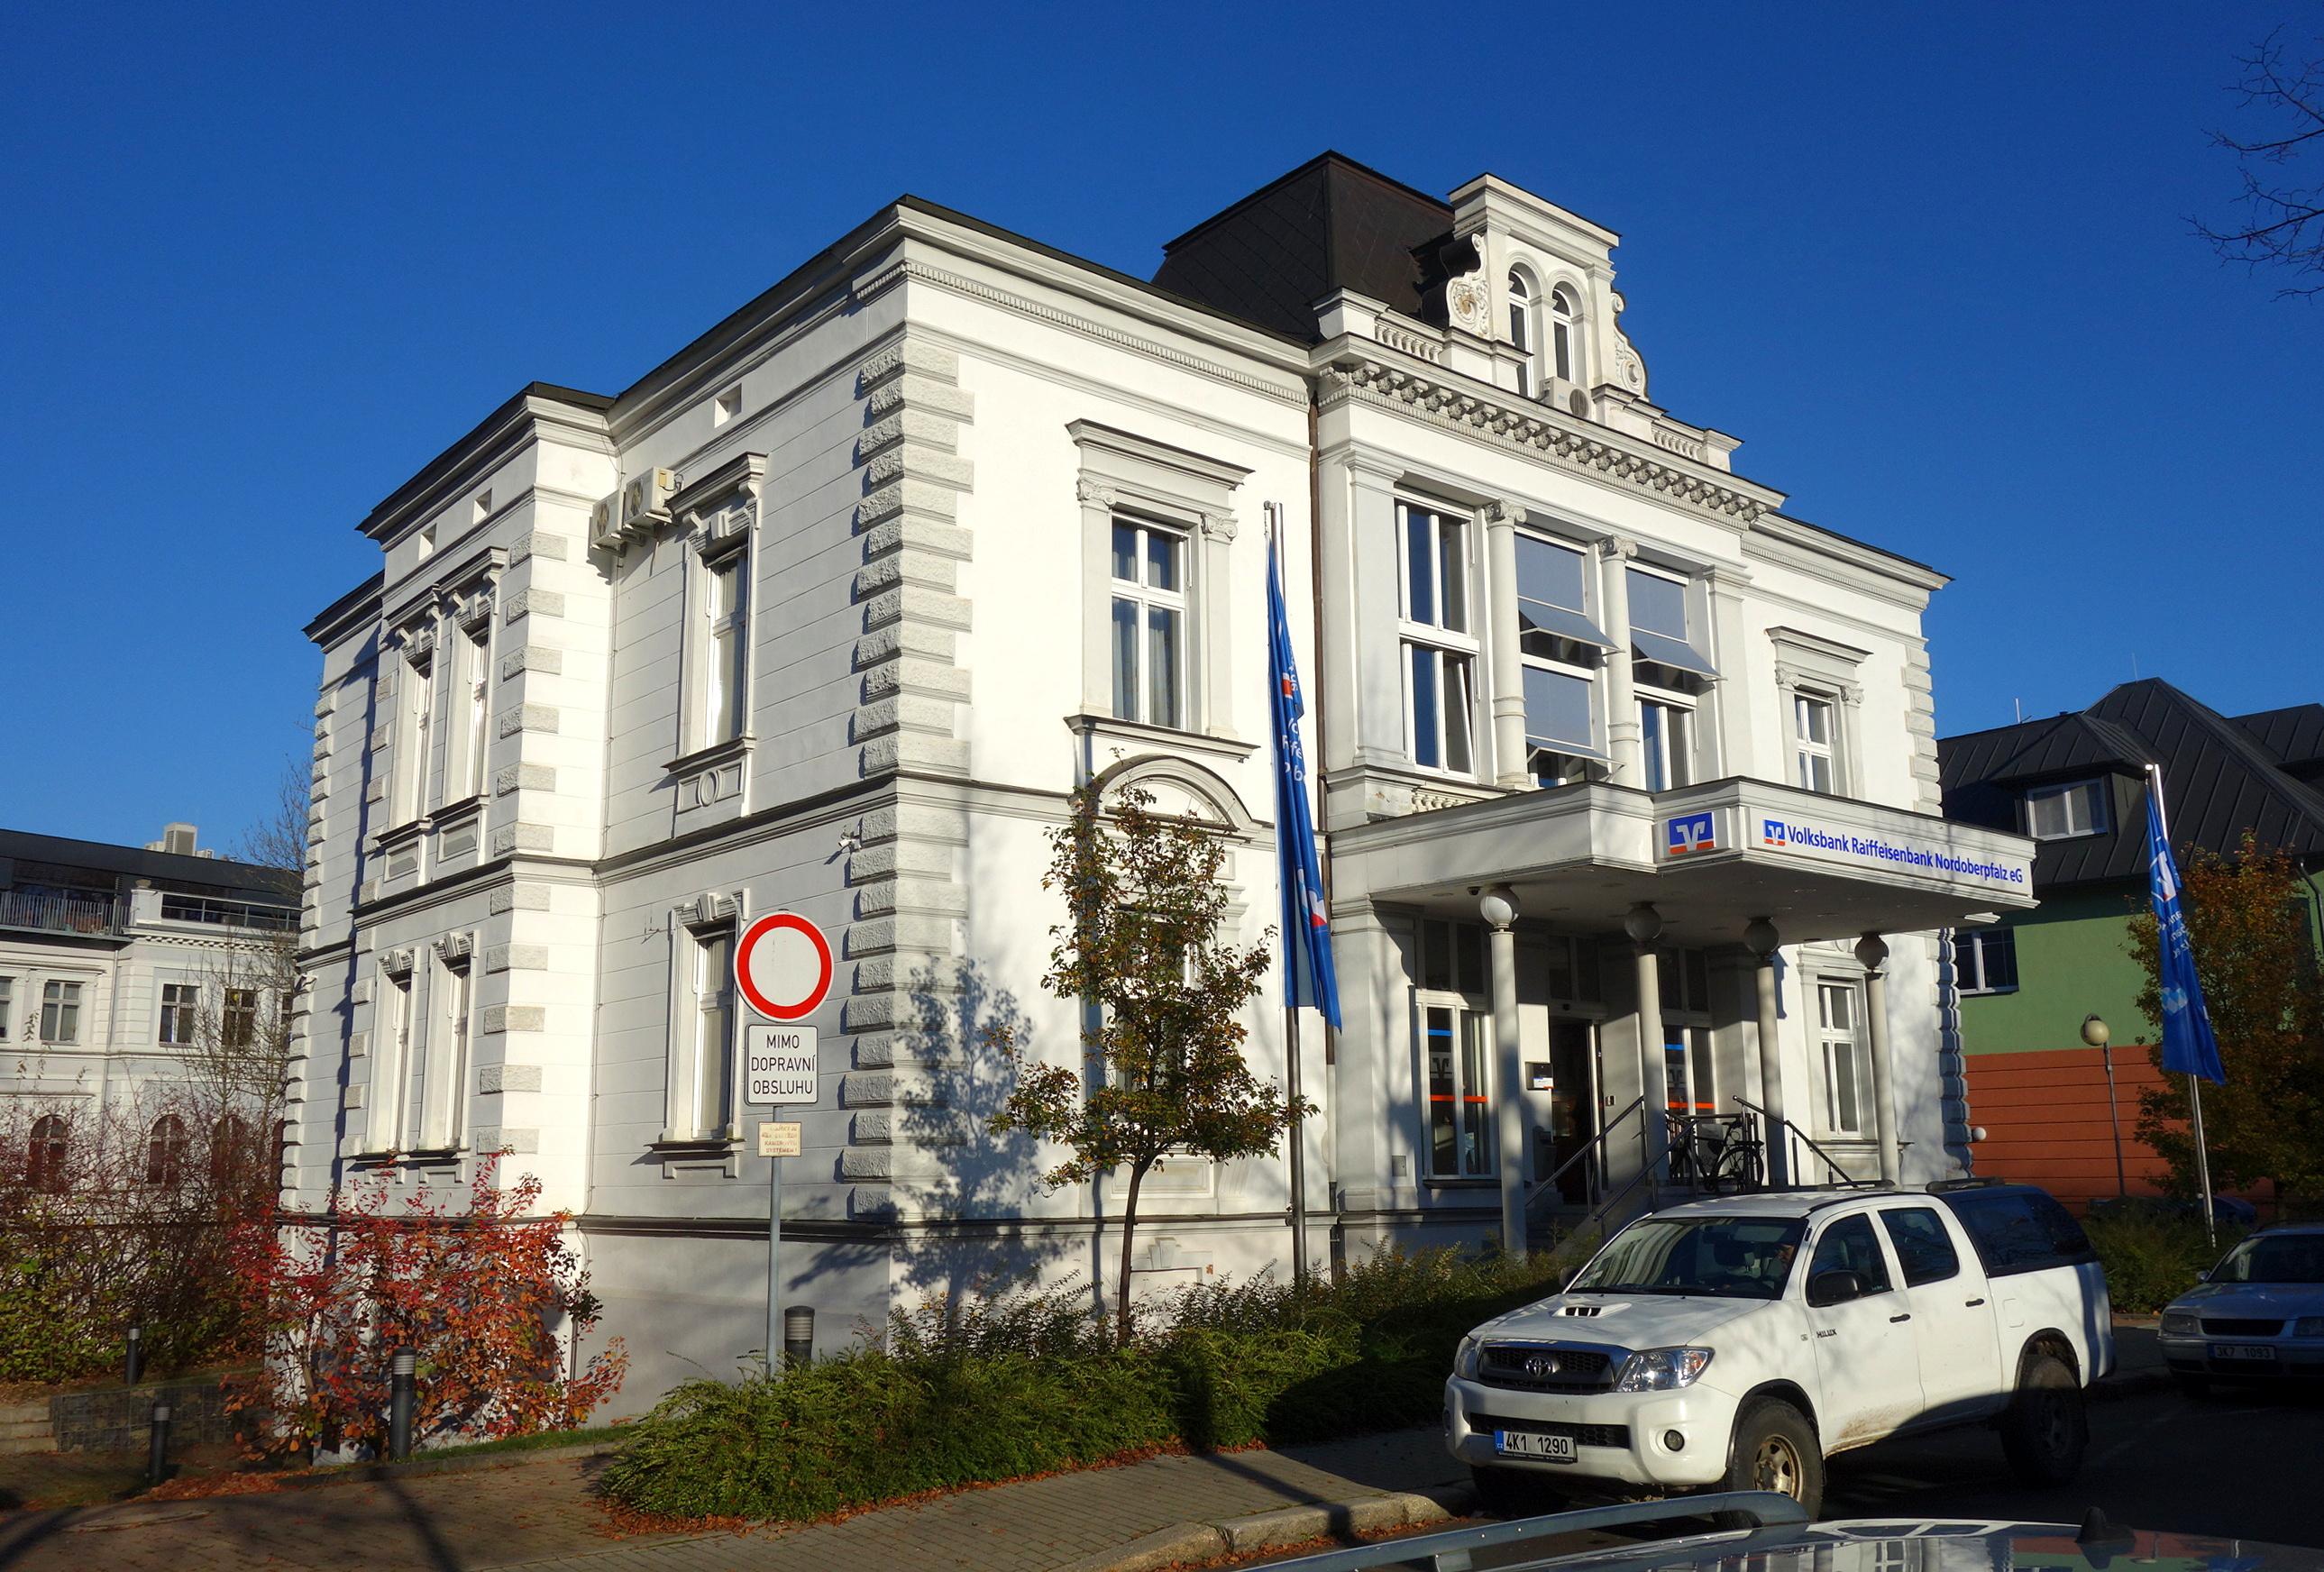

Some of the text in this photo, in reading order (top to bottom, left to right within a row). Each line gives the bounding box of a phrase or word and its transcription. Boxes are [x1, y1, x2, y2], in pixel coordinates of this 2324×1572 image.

[1788, 825, 2023, 883] Volksbank Raiffeisenbank Nordoberpfalz eG
[766, 1035, 800, 1049] MIMO
[751, 1055, 816, 1072] DOPRAVNÍ
[753, 1080, 813, 1094] OBSLUHU
[1816, 1329, 1837, 1339] HILUX
[1505, 1433, 1527, 1451] 4K1
[1537, 1437, 1569, 1455] 1290
